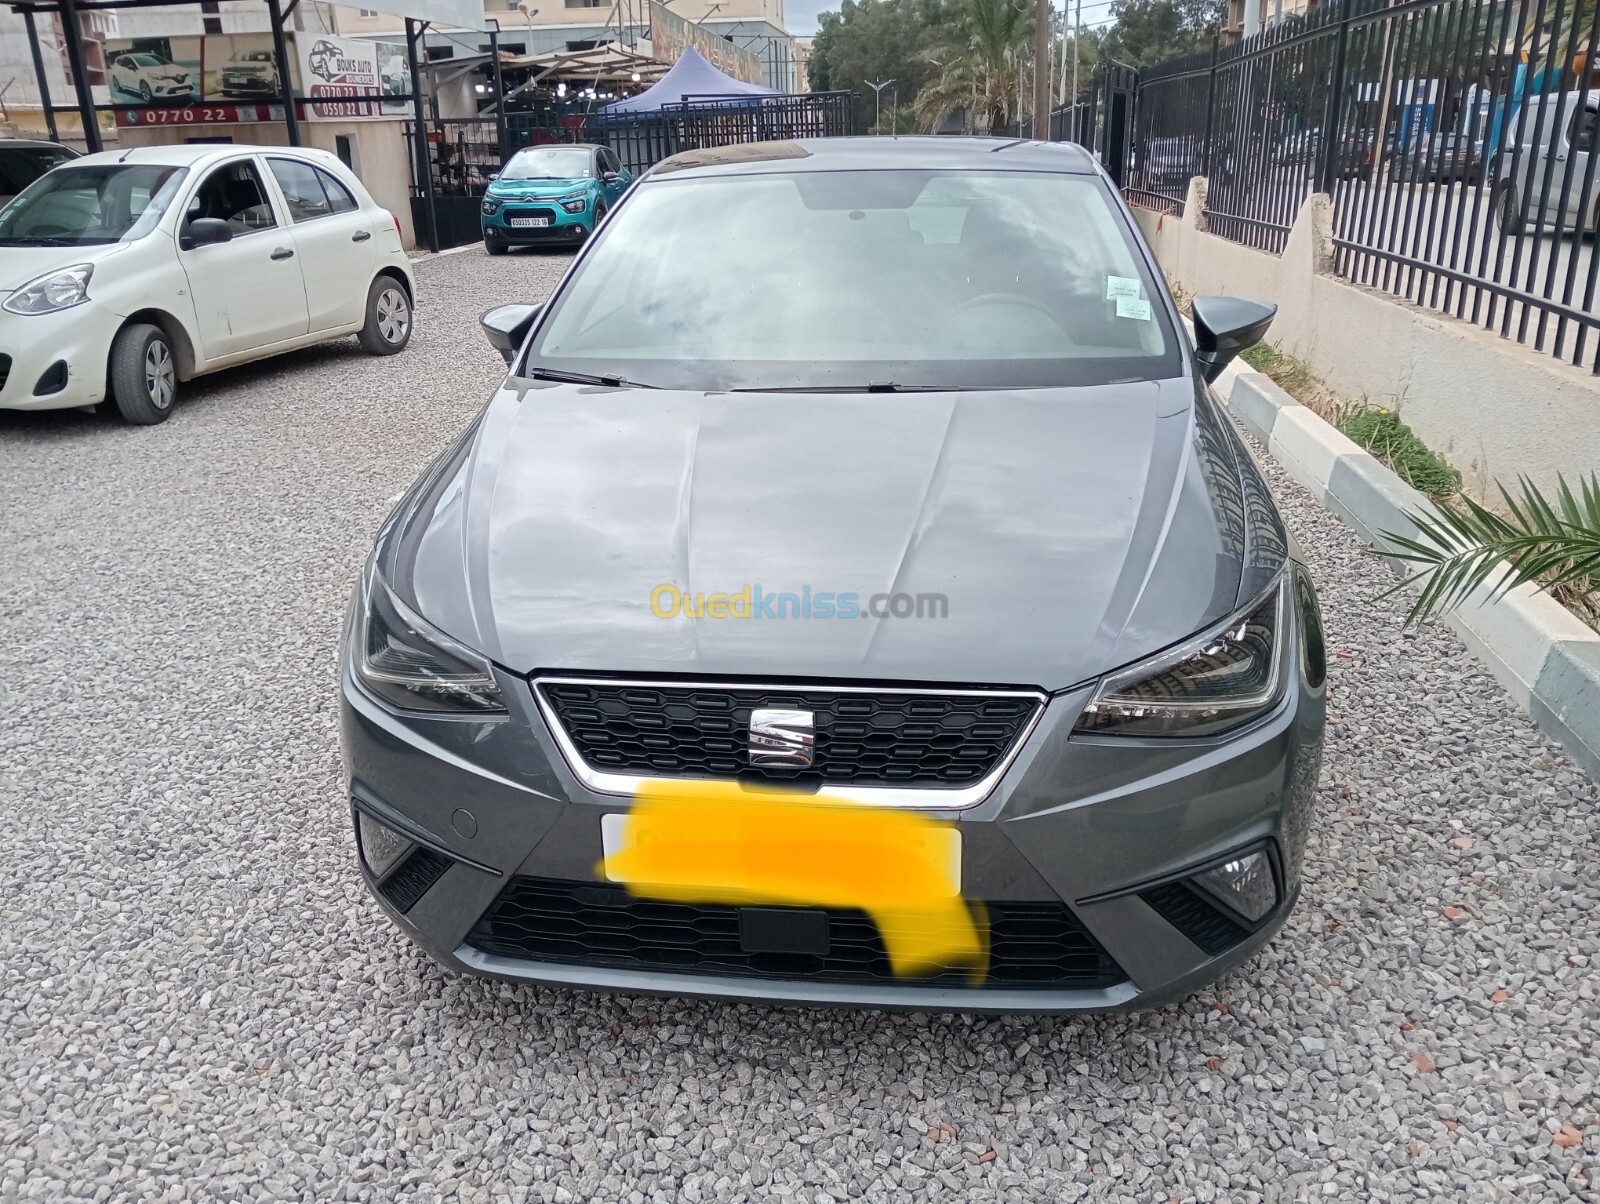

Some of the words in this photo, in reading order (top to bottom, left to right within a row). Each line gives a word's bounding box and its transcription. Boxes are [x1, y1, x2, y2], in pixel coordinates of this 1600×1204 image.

[357, 60, 371, 73] AUTO
[320, 86, 341, 98] 0770
[323, 102, 343, 115] 0550
[347, 102, 356, 115] 22
[146, 110, 194, 123] 0770
[203, 109, 226, 121] 22
